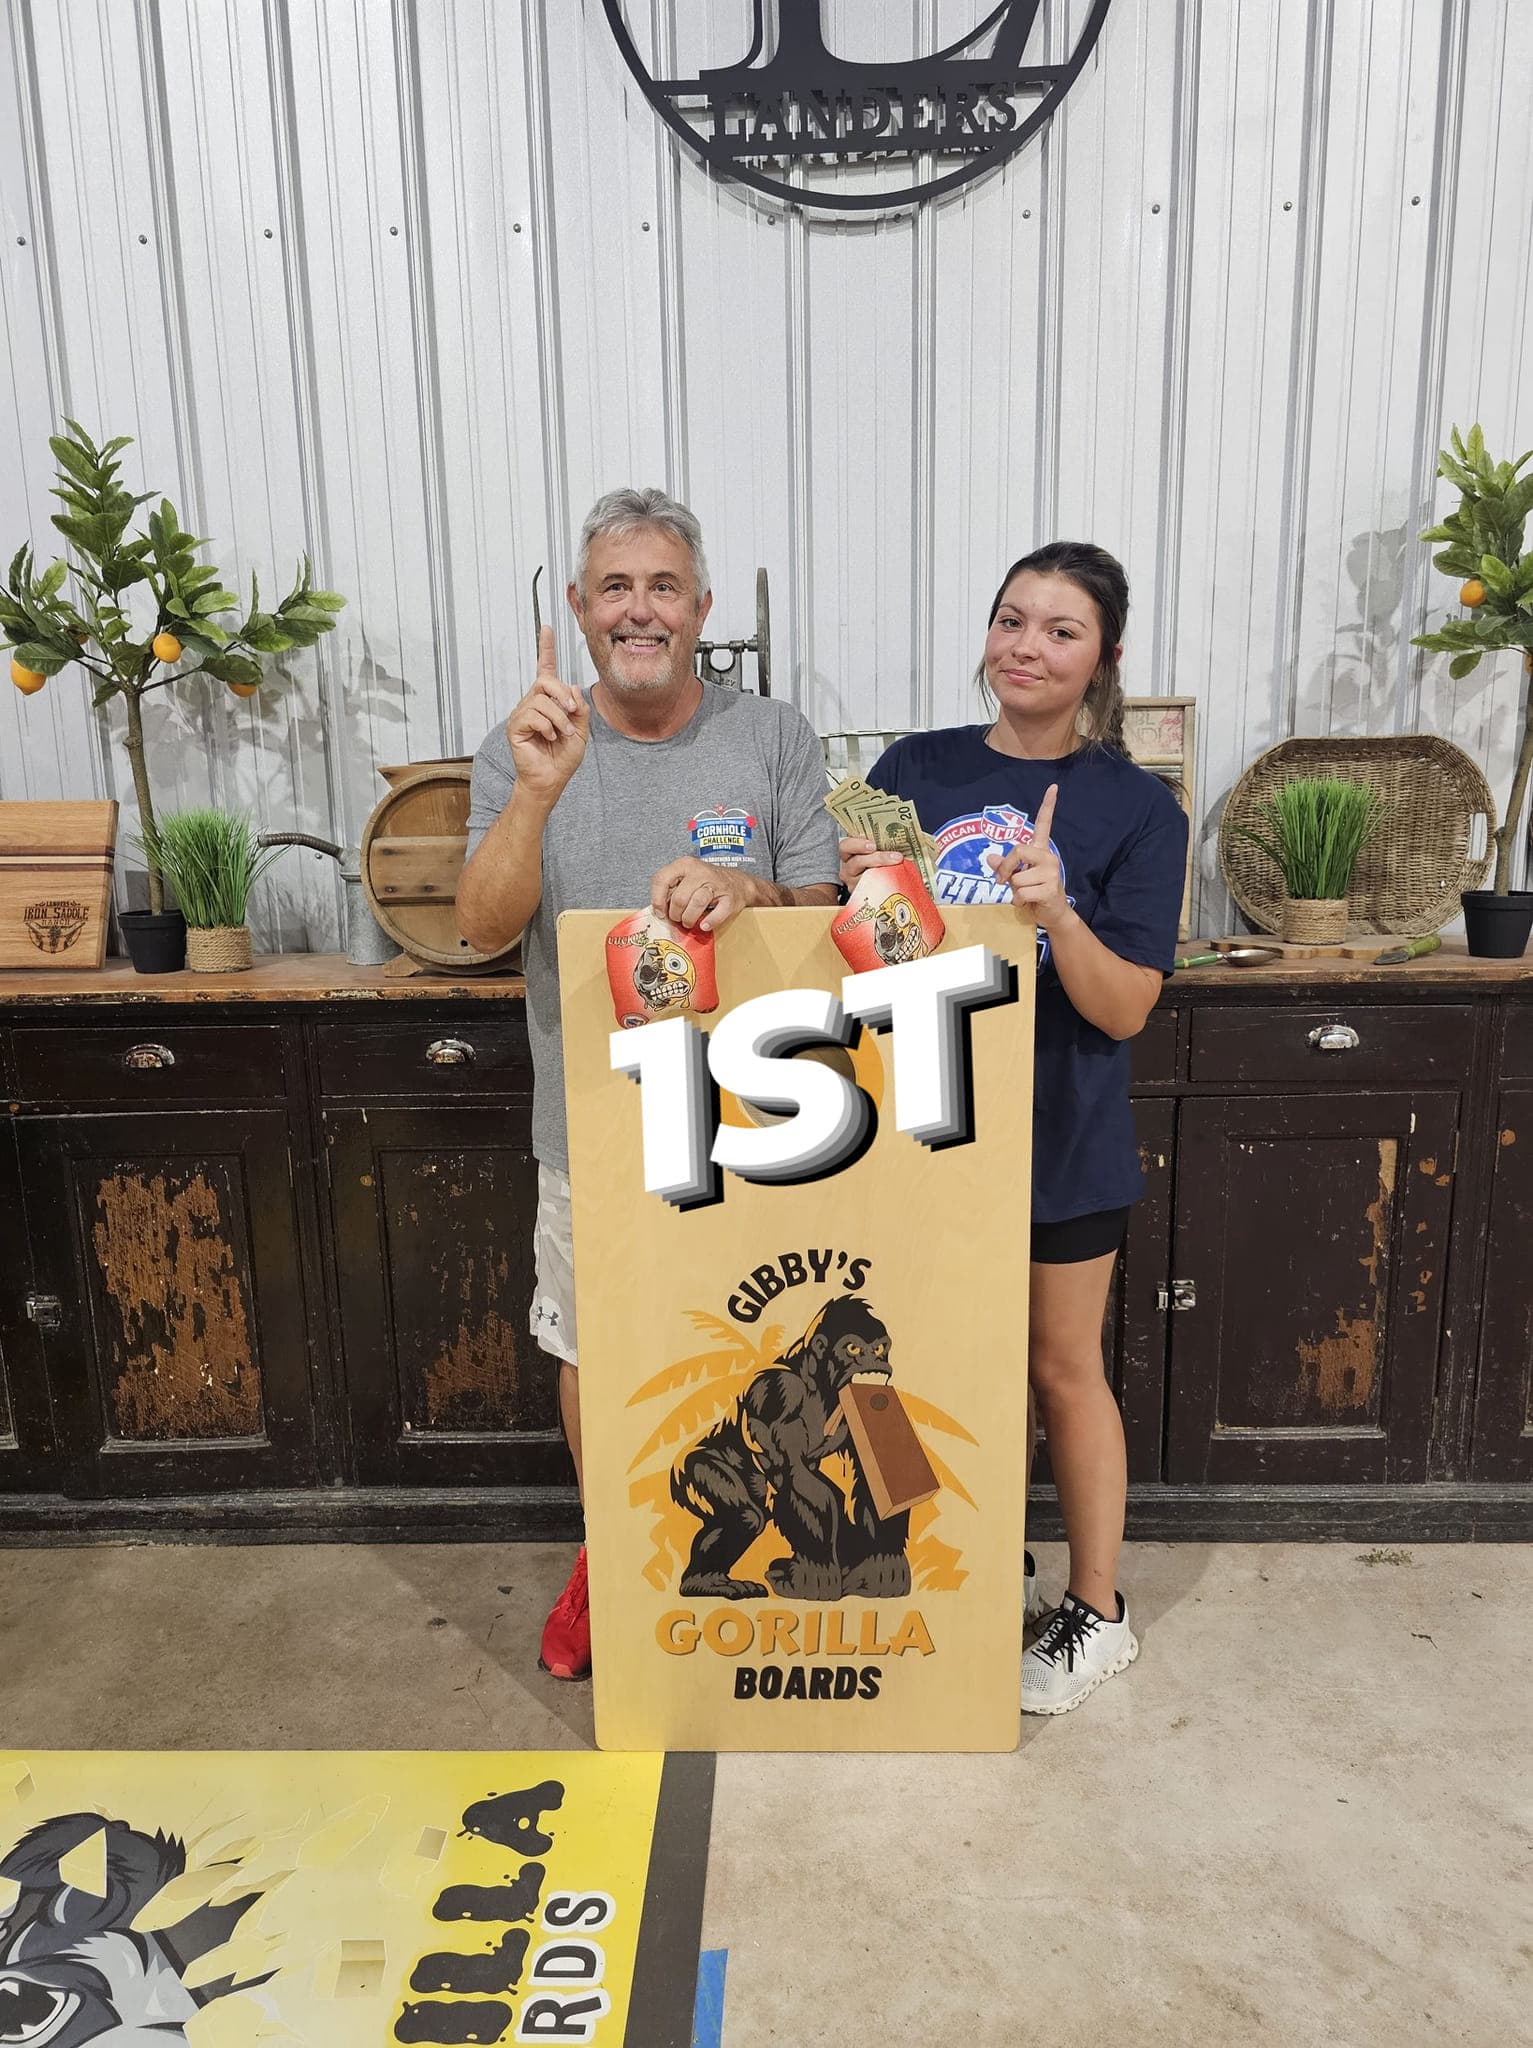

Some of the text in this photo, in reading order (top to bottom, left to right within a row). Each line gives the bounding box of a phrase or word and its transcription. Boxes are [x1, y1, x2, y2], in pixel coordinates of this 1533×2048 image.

[706, 82, 1018, 141] LANDERS
[897, 806, 913, 821] 20
[696, 824, 747, 838] CORNHOLE
[702, 836, 742, 845] CHALLENGE
[937, 825, 976, 849] ERICAN
[24, 906, 90, 921] IRON SADDLE
[726, 1248, 872, 1324] GIBBY'S
[655, 1608, 937, 1657] GORILLA
[734, 1666, 882, 1700] BOARDS
[394, 1779, 566, 2046] ILLA
[521, 1896, 608, 2036] RDS
